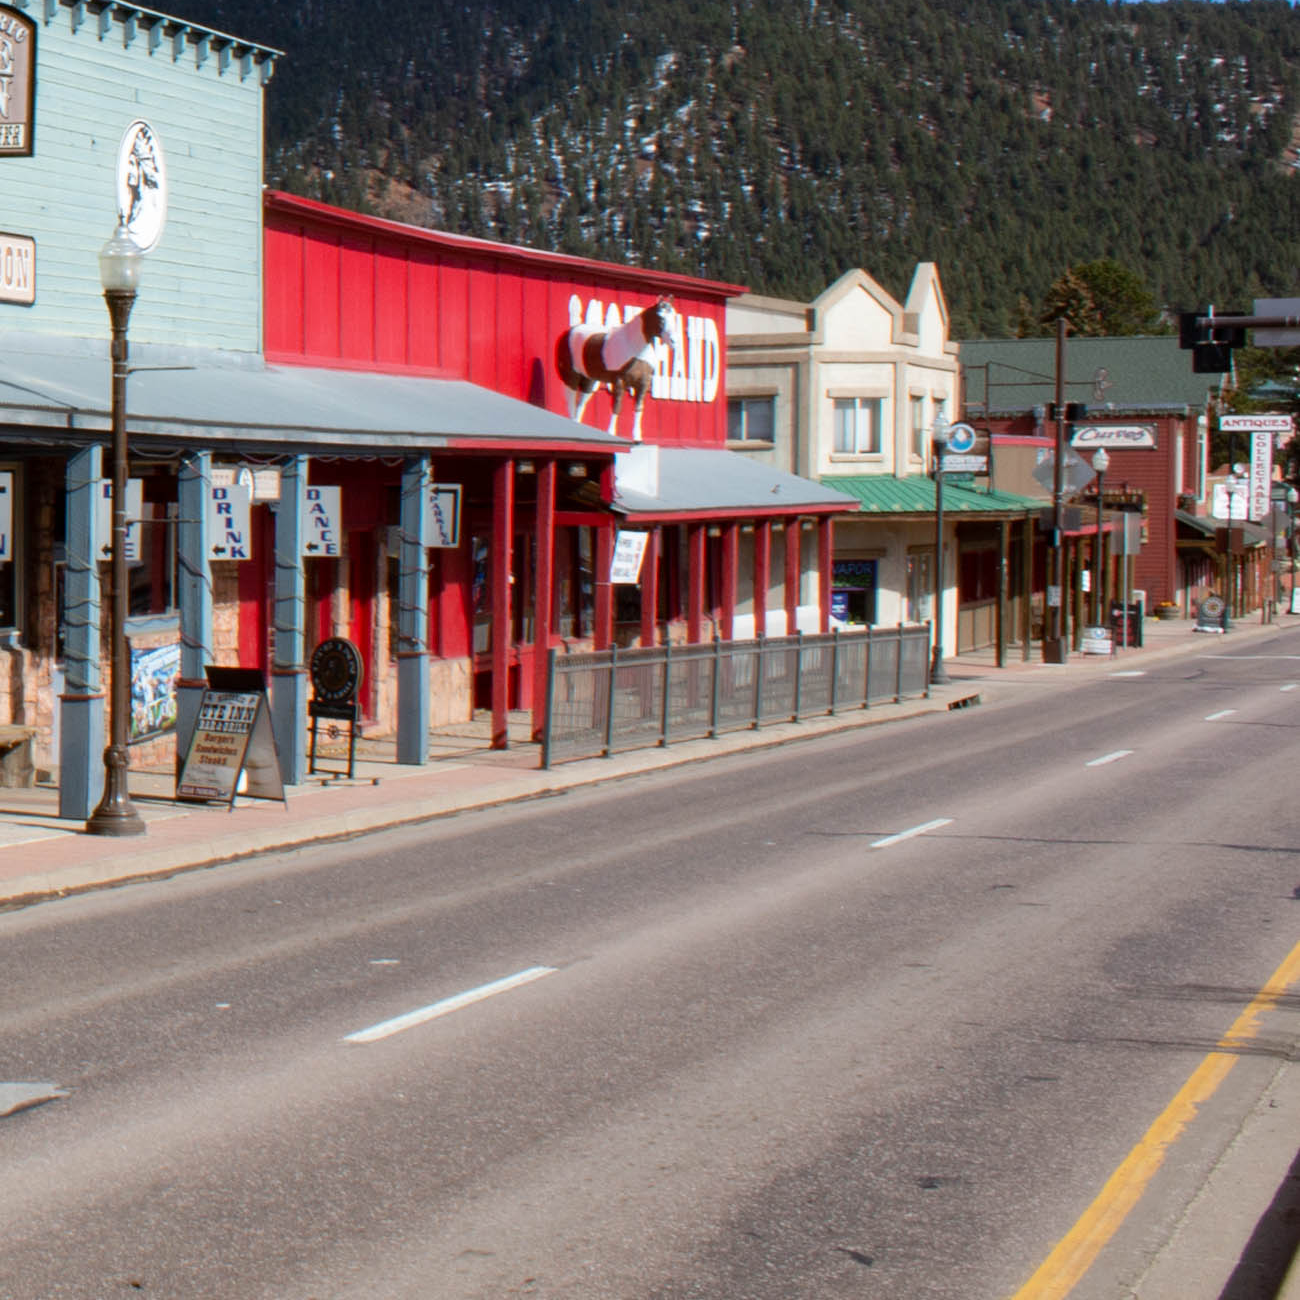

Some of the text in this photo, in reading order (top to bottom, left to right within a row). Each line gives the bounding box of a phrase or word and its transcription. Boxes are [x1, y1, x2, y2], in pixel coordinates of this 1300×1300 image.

[1223, 418, 1289, 429] ANTIQUES
[1079, 427, 1145, 442] Curves
[212, 487, 248, 559] DRINK
[306, 488, 338, 555] DANCE
[204, 732, 235, 744] Burgers
